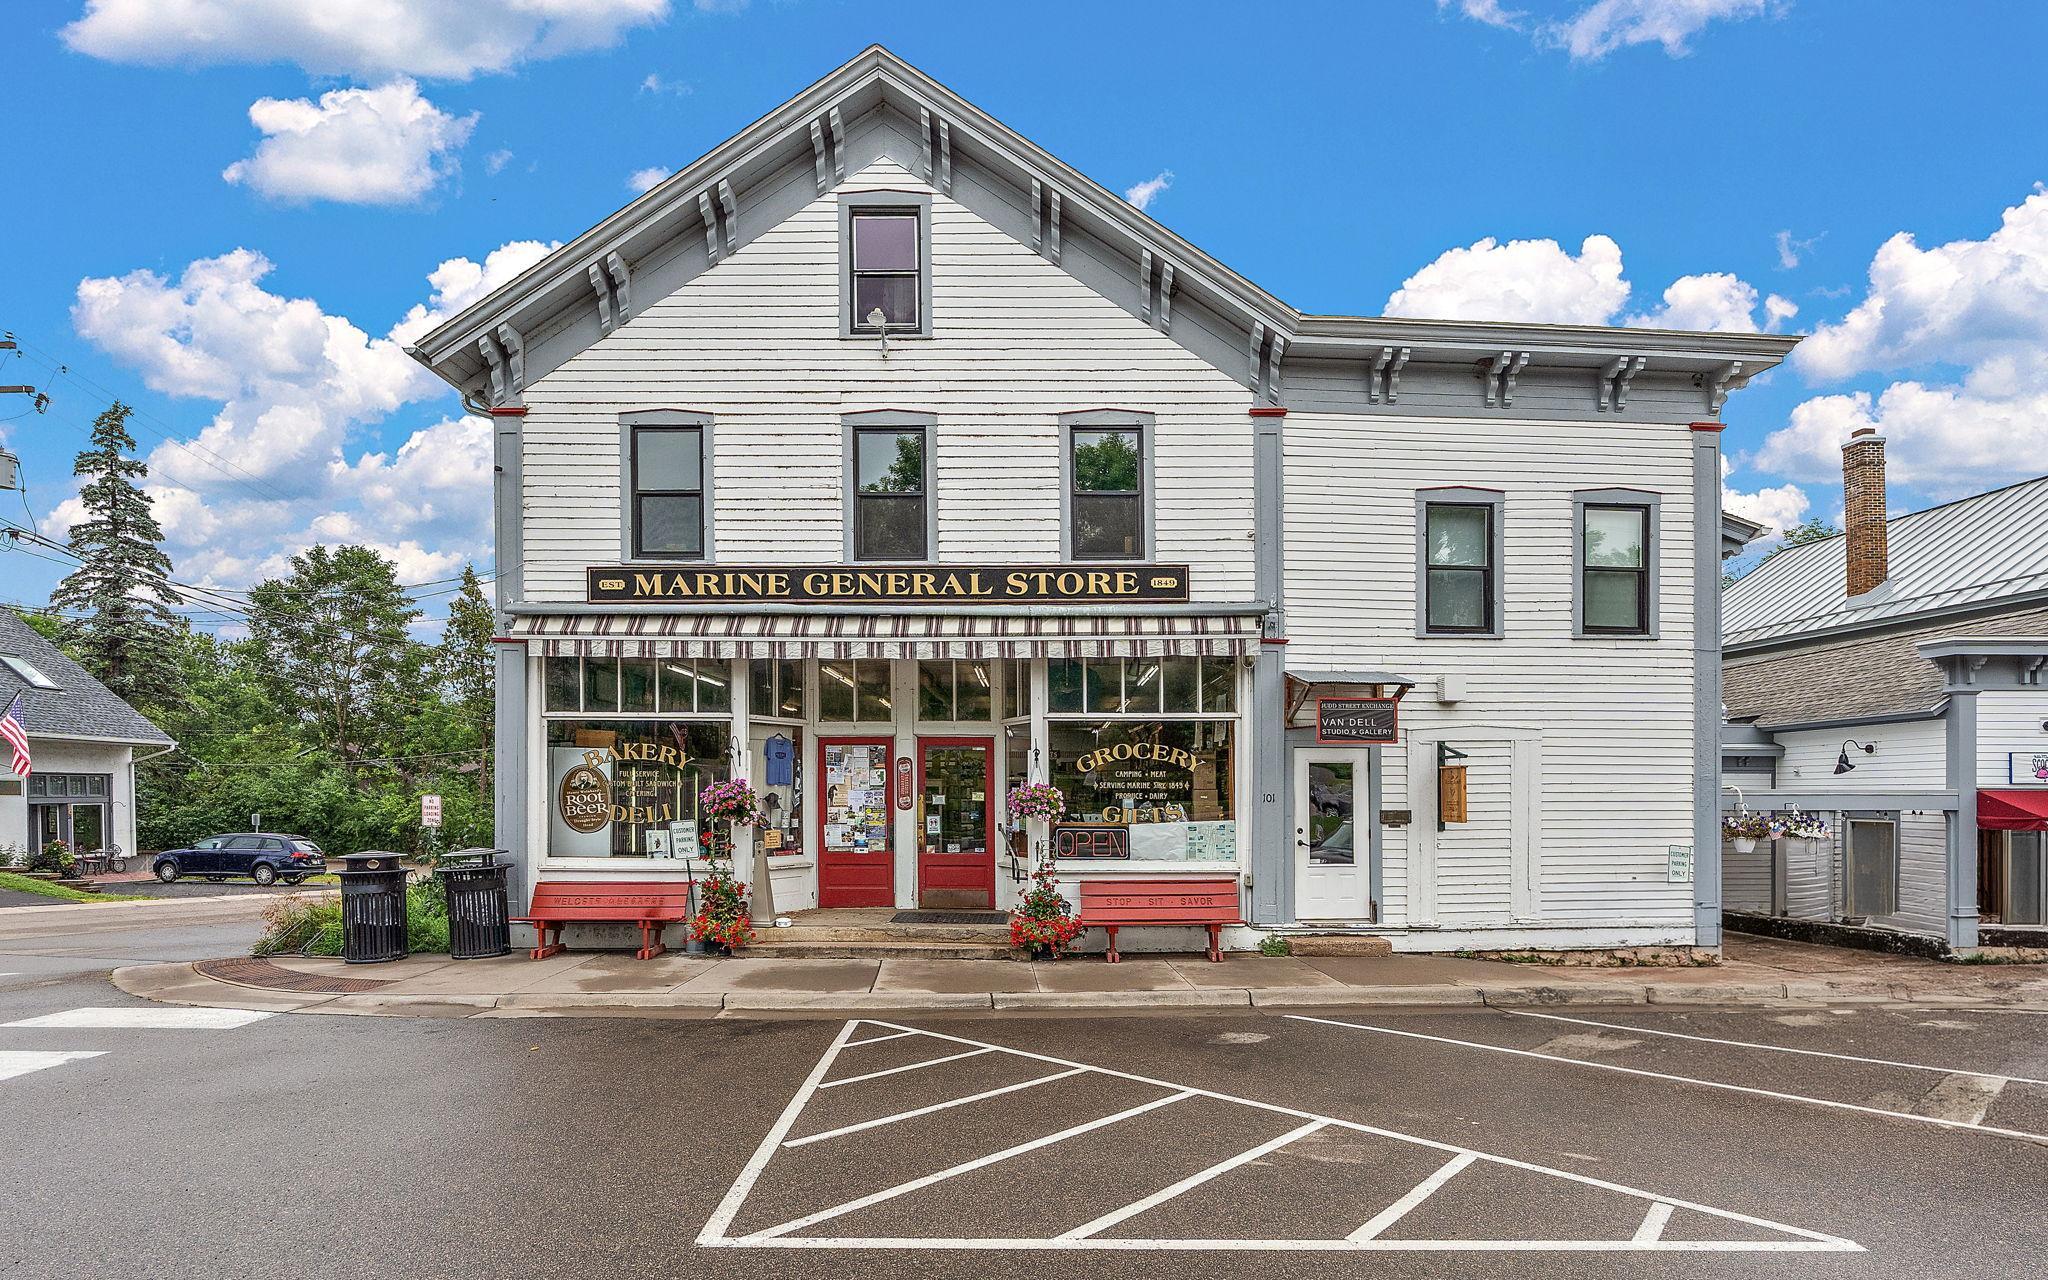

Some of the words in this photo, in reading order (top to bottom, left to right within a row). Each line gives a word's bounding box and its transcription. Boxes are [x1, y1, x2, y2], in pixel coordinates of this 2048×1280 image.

[600, 580, 624, 589] EST.
[633, 573, 790, 596] MARINE
[803, 573, 992, 596] GENERAL
[1005, 572, 1139, 595] STORE
[1152, 579, 1176, 587] 1849
[1322, 718, 1344, 727] VAN
[1349, 718, 1377, 727] DELL
[582, 742, 695, 770] BAKERY
[1076, 743, 1206, 773] GROCERY
[1100, 781, 1125, 789] SERVING
[1127, 781, 1150, 789] MARINE
[1168, 781, 1184, 789] 1849
[1263, 793, 1275, 803] 101
[609, 803, 672, 824] DELI
[1102, 804, 1183, 824] GIFTS
[1059, 831, 1126, 857] OPEN
[1106, 897, 1132, 906] STOP
[1148, 897, 1164, 906] SIT
[1180, 897, 1214, 906] SAVOR
